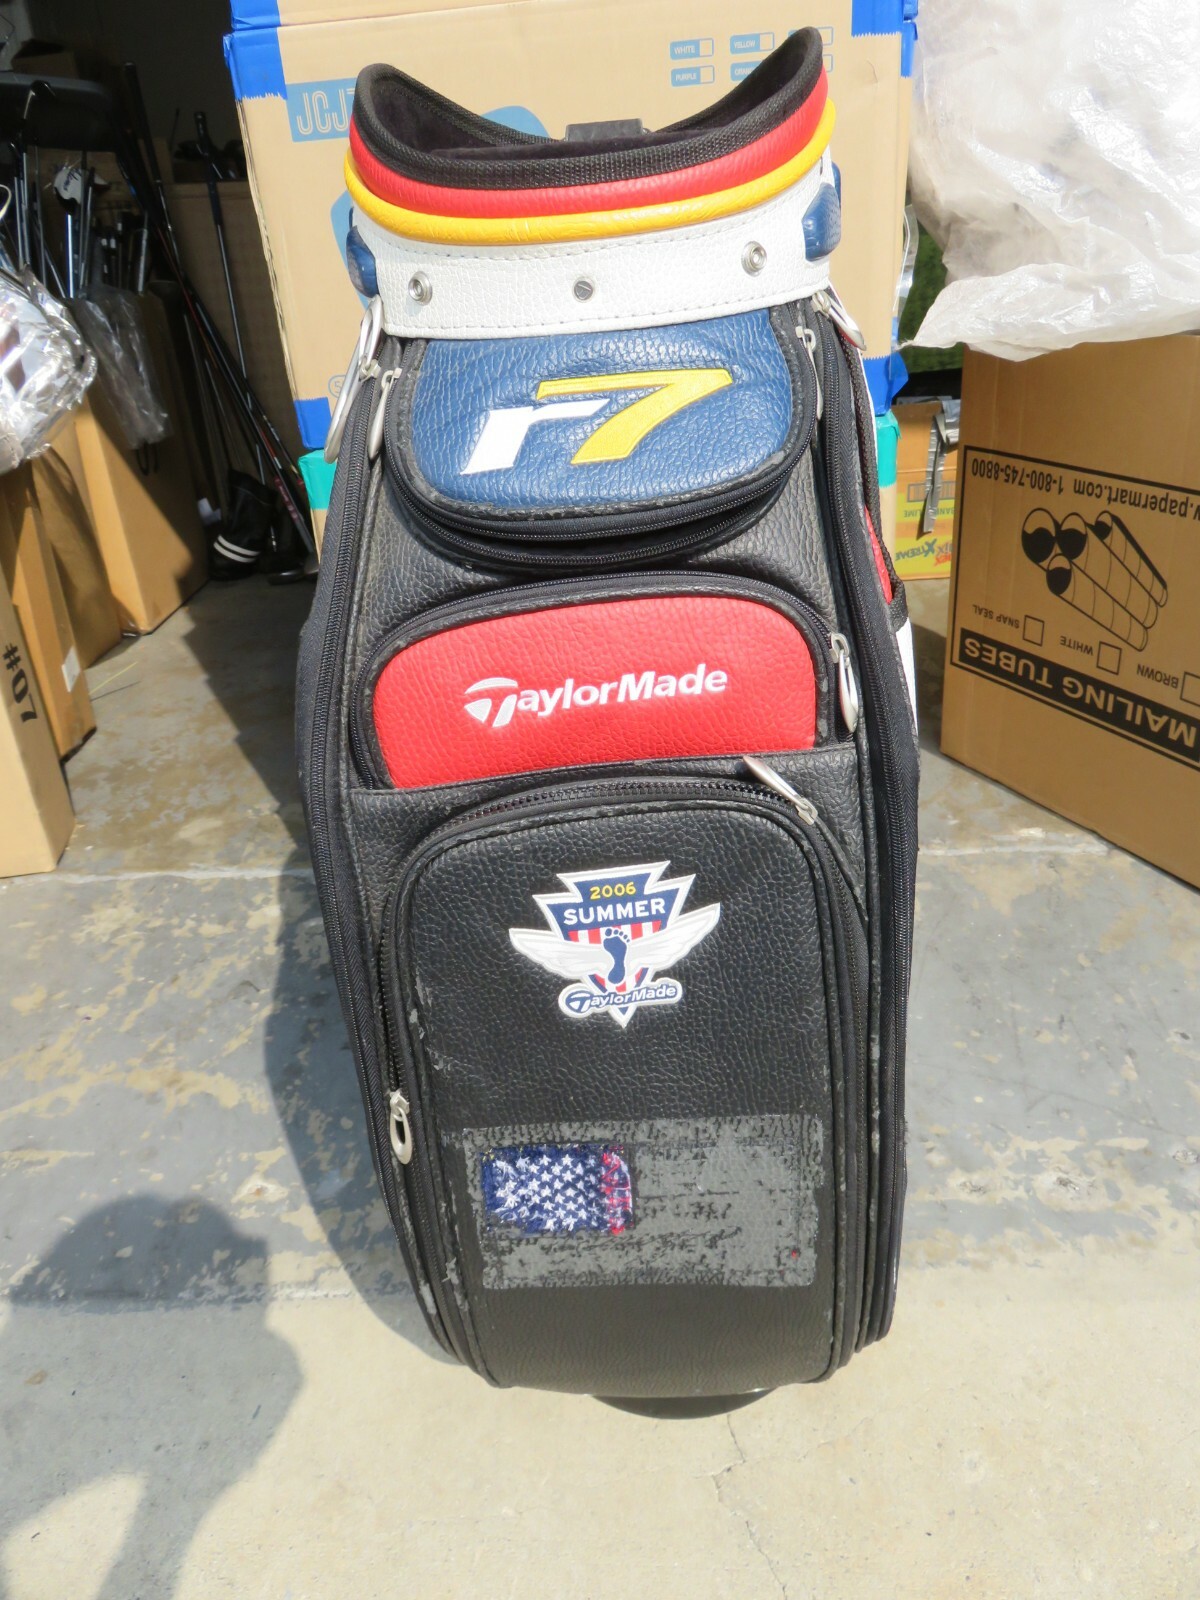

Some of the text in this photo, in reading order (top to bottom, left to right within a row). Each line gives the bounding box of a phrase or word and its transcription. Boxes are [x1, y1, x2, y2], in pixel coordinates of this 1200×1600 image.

[674, 45, 696, 55] WHITE
[734, 39, 756, 49] YELLOW
[675, 72, 697, 81] PURPLE
[296, 88, 355, 135] JCJ
[972, 457, 1064, 495] 1-800-745-8800
[972, 604, 1020, 628] SNAP SEAL
[1060, 635, 1094, 656] WHITE
[1136, 664, 1179, 688] BROWN
[464, 663, 728, 728] TaylorMade
[964, 637, 1197, 748] MAILING TUBES
[589, 881, 637, 900] 2006
[563, 898, 666, 925] SUMMER
[565, 984, 676, 1012] TaylorMade
